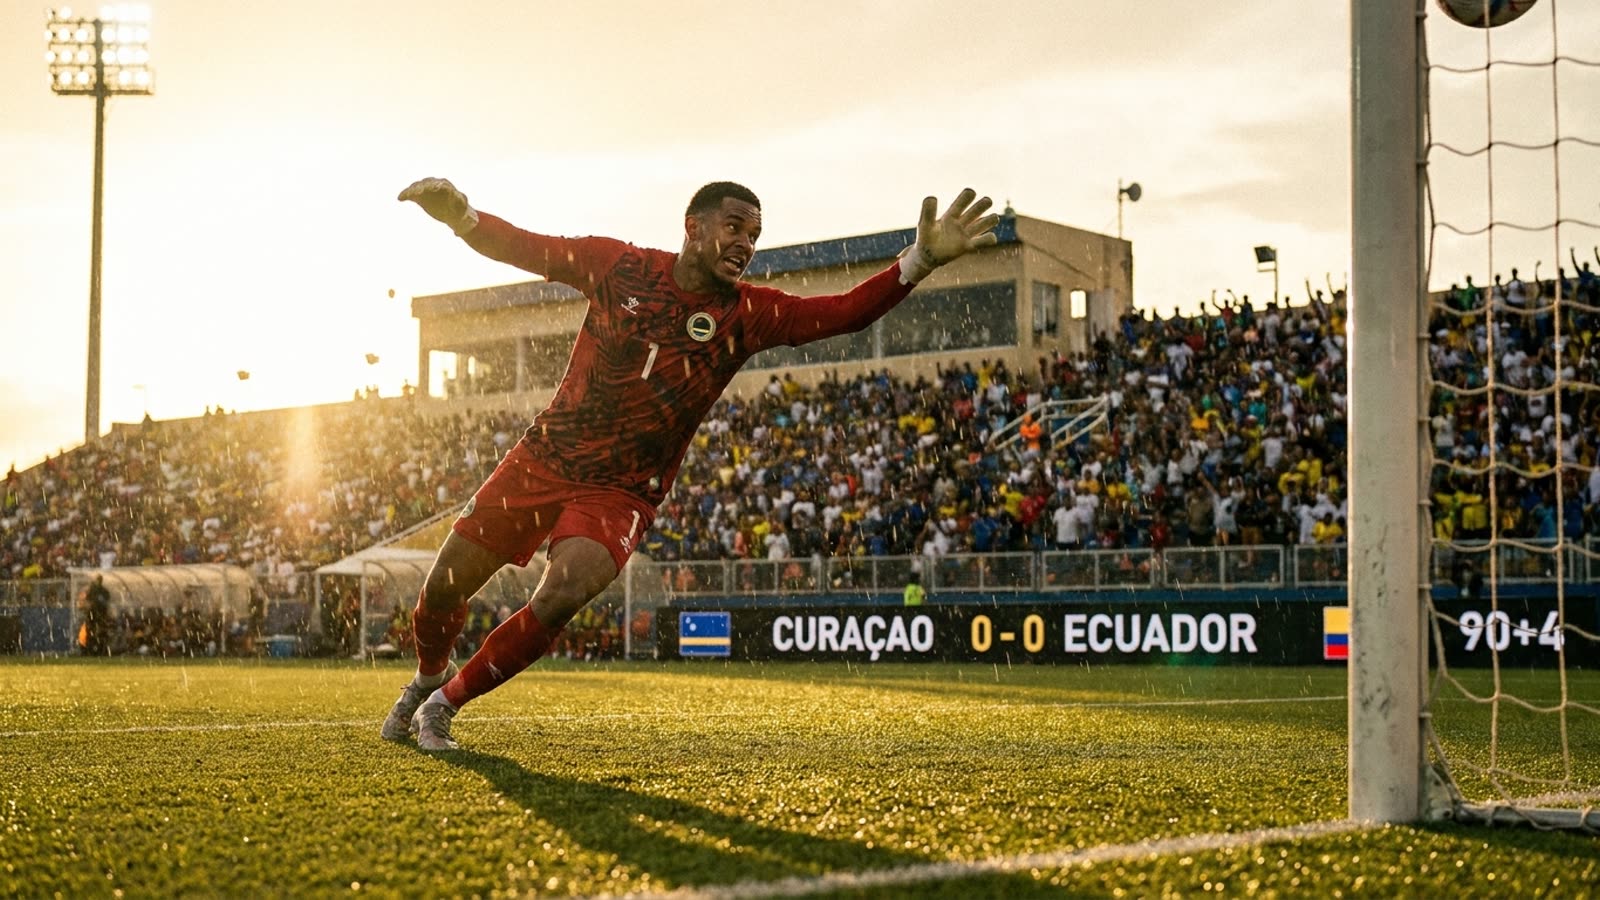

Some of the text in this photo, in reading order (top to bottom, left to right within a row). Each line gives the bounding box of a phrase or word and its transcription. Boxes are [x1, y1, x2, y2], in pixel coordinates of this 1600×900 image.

[640, 342, 660, 380] 1
[629, 510, 640, 539] 1
[772, 615, 934, 661] CURAÇAO
[1064, 613, 1258, 653] ECUADOR
[1459, 610, 1565, 651] 90+4
